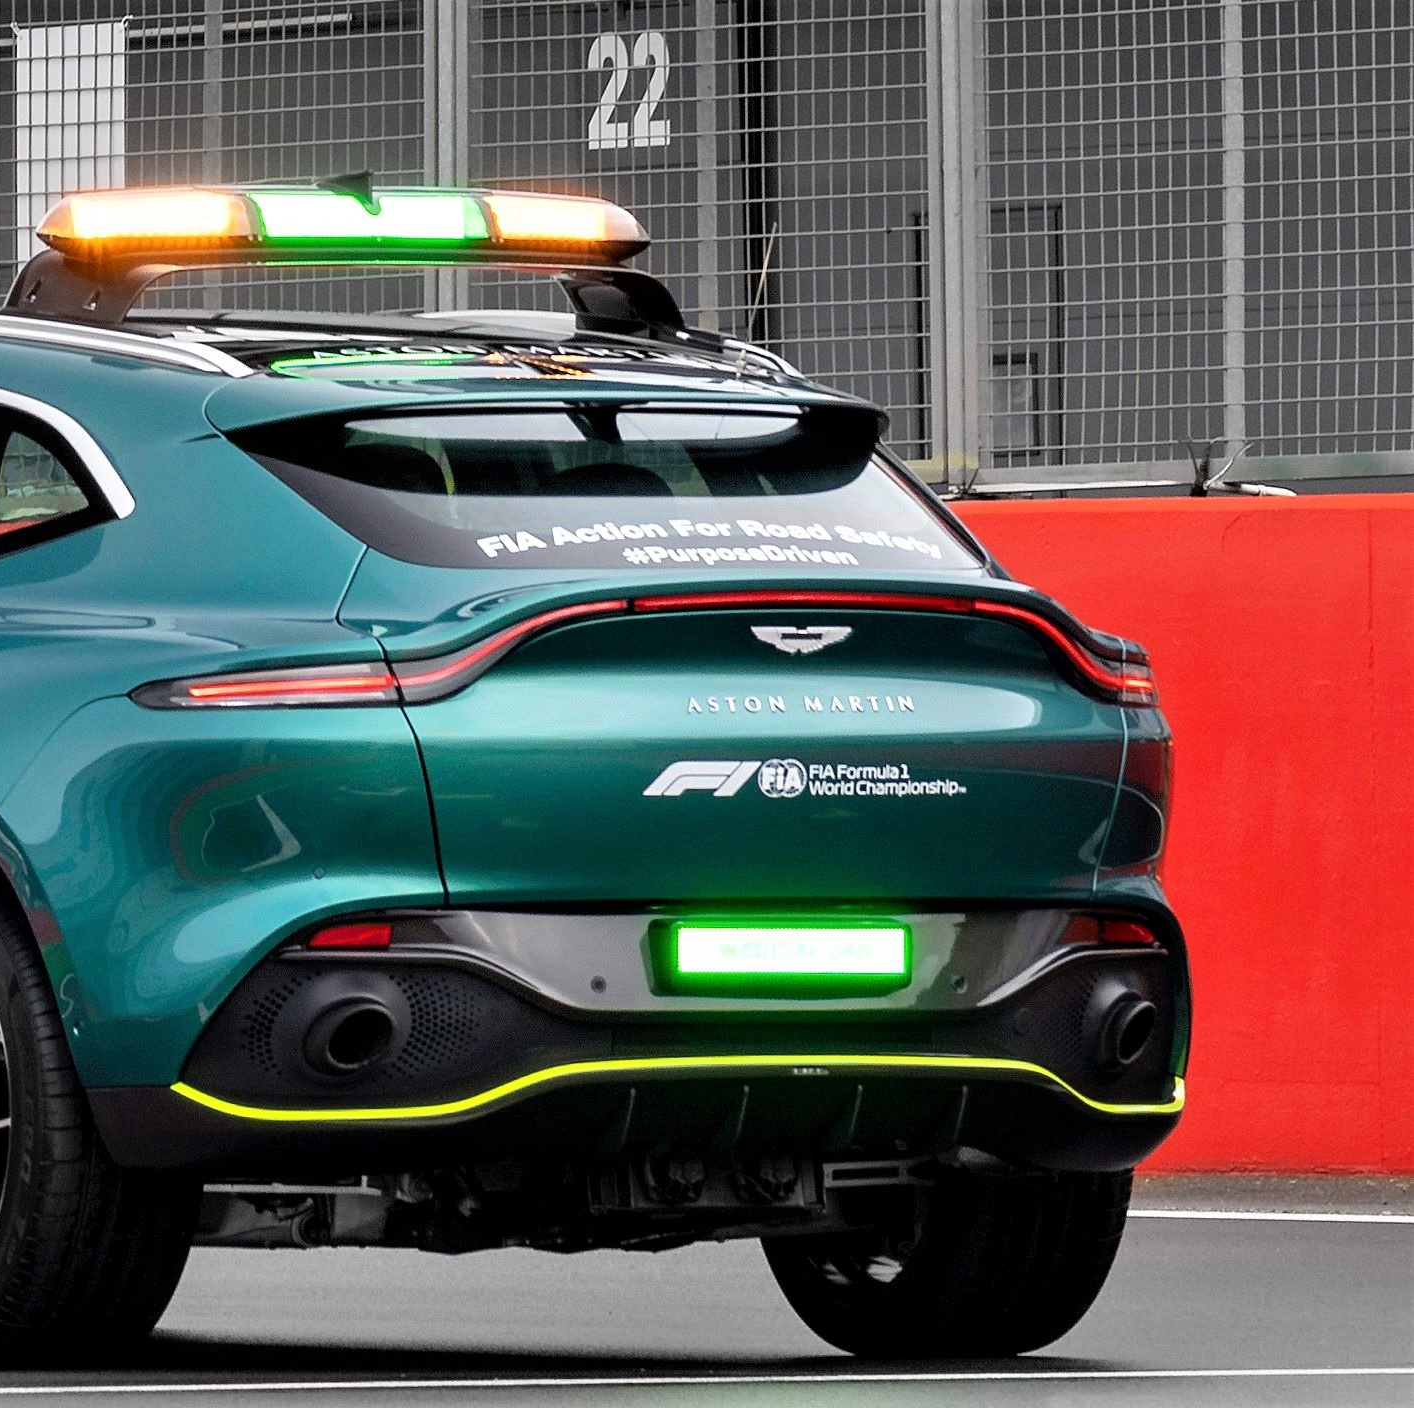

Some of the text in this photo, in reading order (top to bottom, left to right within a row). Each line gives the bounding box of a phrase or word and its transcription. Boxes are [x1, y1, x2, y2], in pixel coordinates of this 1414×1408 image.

[588, 31, 671, 150] 22
[476, 519, 942, 559] FIA Action For Road Safety
[623, 544, 859, 566] #PurposeDriven
[687, 695, 916, 713] ASTON MARTIN
[809, 764, 910, 780] FIA Formula 1
[809, 781, 854, 796] World
[856, 779, 959, 797] Championship
